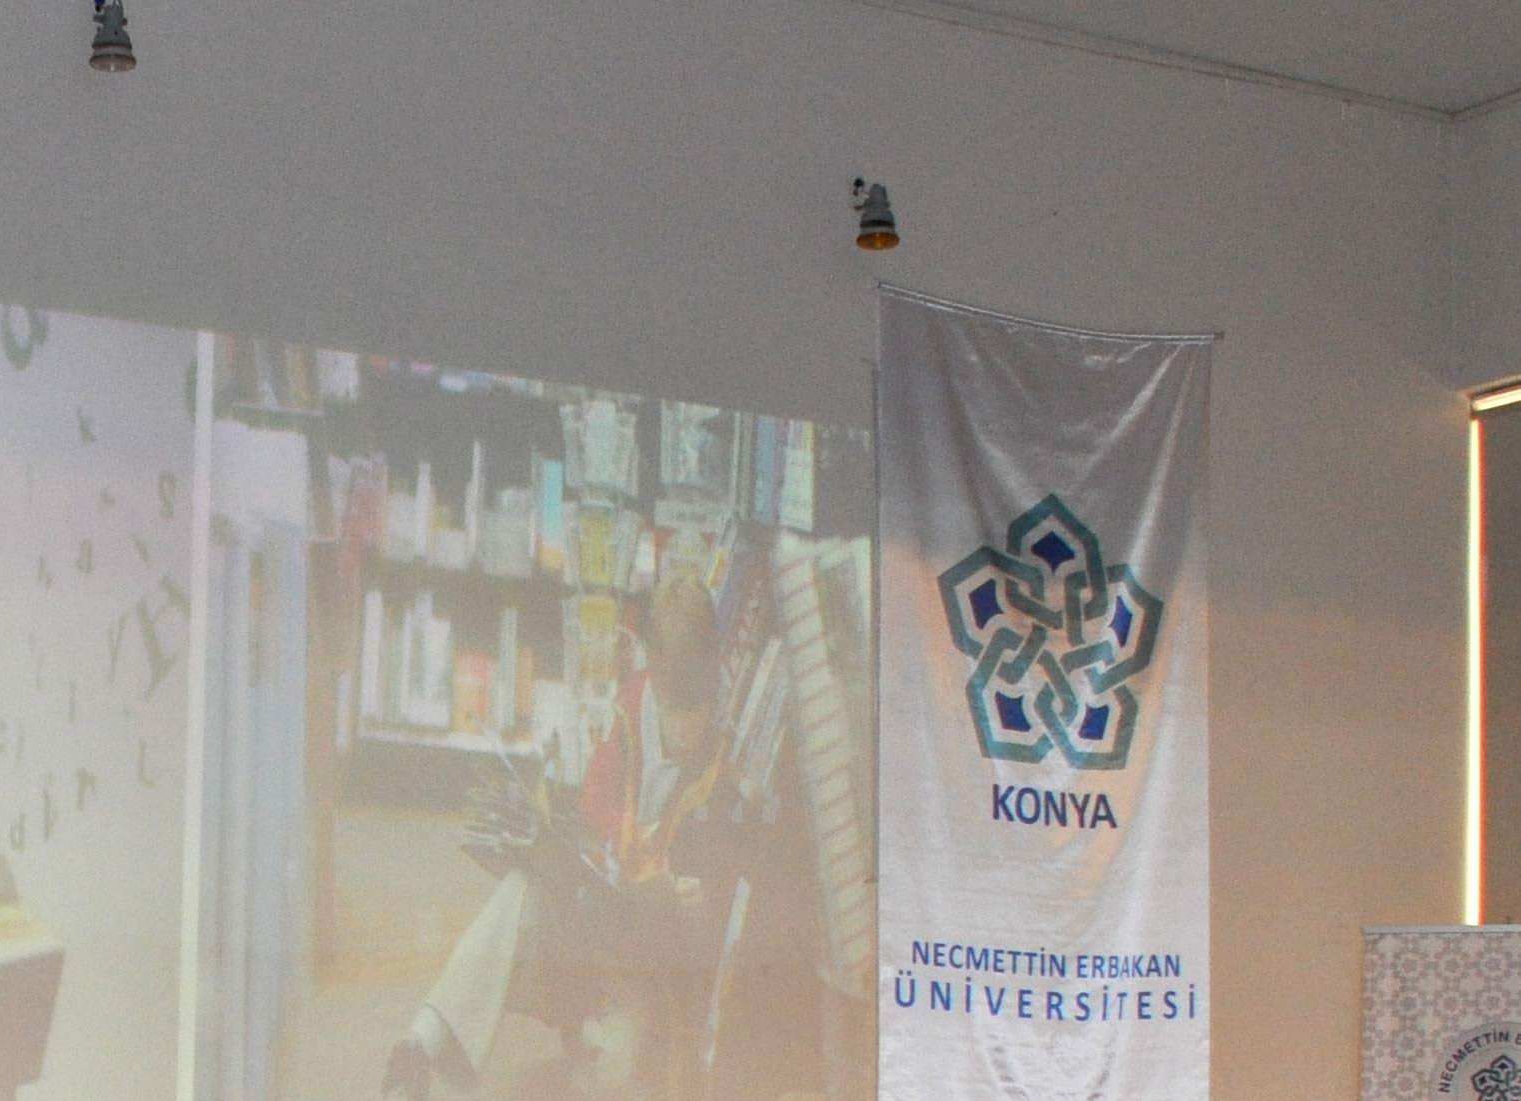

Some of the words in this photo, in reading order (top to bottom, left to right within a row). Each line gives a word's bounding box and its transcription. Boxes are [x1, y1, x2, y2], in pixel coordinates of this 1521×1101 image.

[992, 784, 1117, 829] KONYA
[912, 940, 1067, 978] NECMETTİN
[1077, 954, 1181, 979] ERBAKAN
[894, 970, 1196, 1021] ÜNİVERSİTESİ
